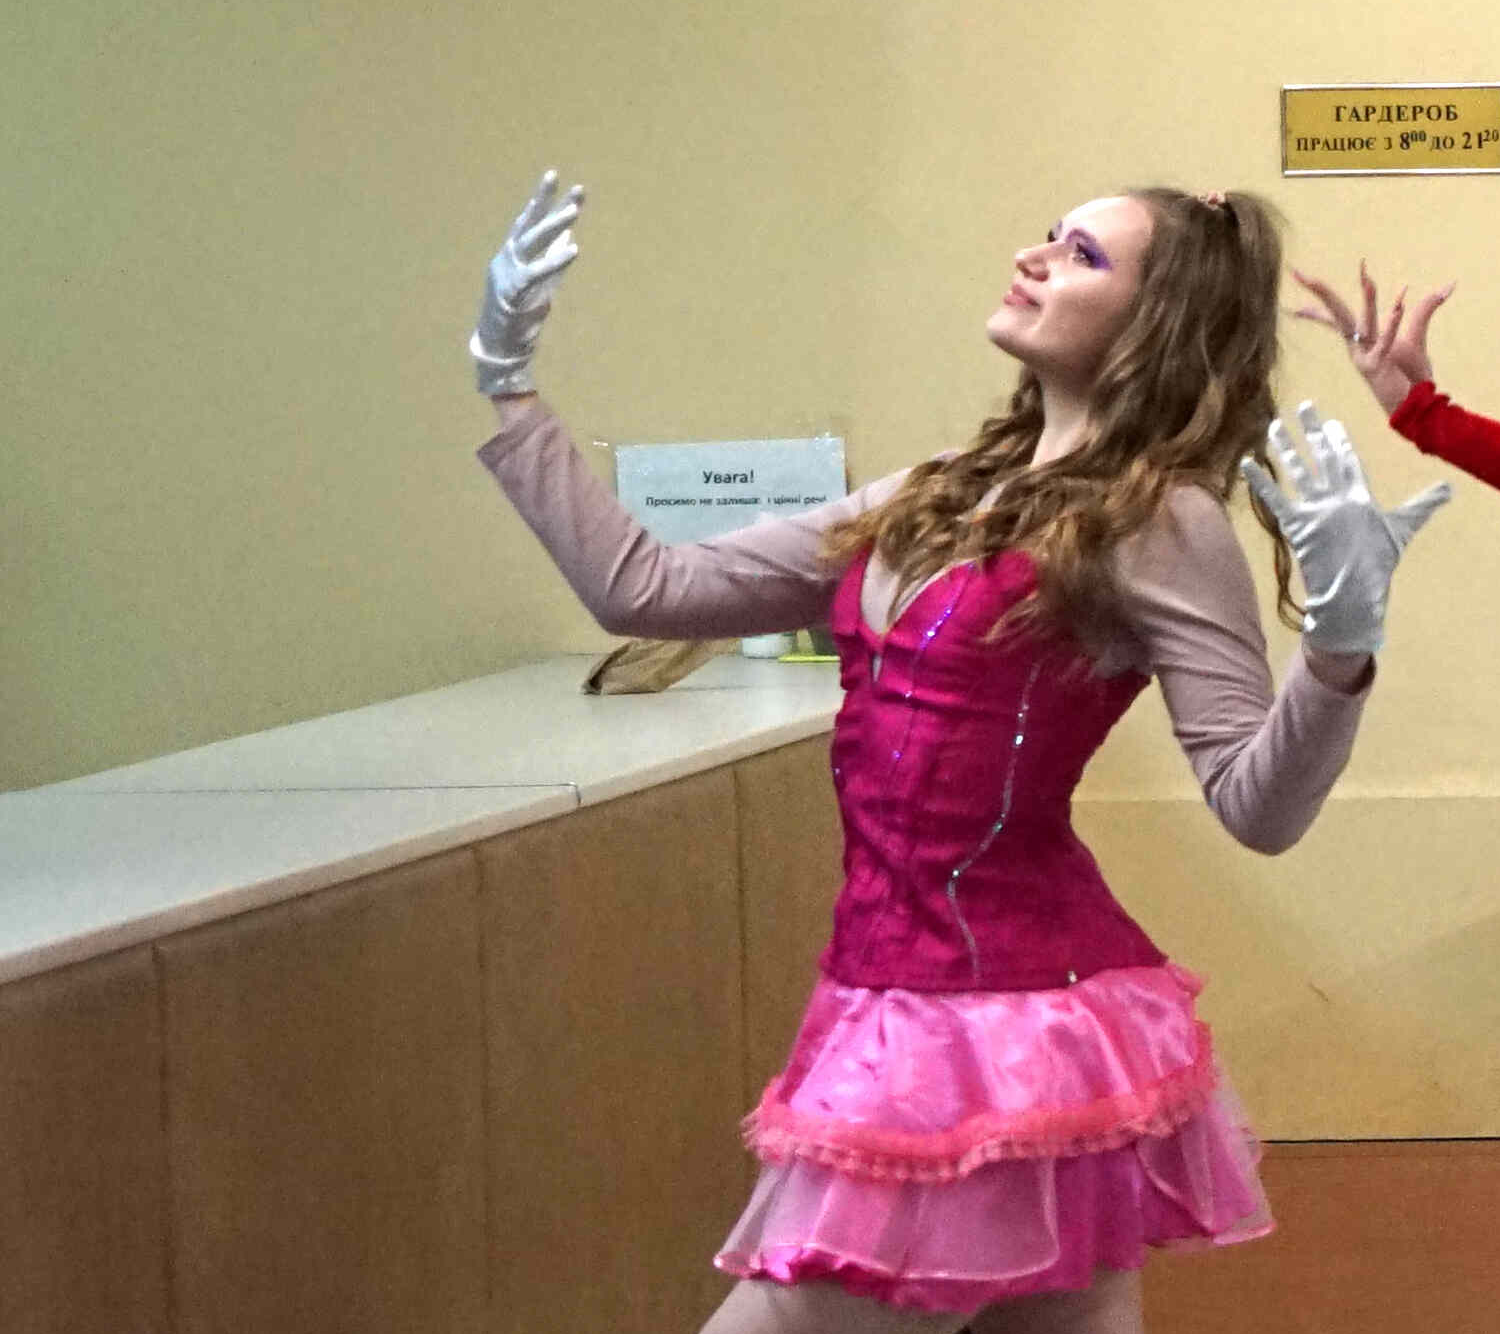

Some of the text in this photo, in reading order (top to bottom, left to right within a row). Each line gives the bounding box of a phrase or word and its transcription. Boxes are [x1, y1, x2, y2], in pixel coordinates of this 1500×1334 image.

[1333, 104, 1459, 123] ГАРДЕРОБ
[1296, 136, 1377, 153] ПРАЦЮЄ
[702, 469, 755, 484] Увага!
[646, 496, 697, 507] Просимо
